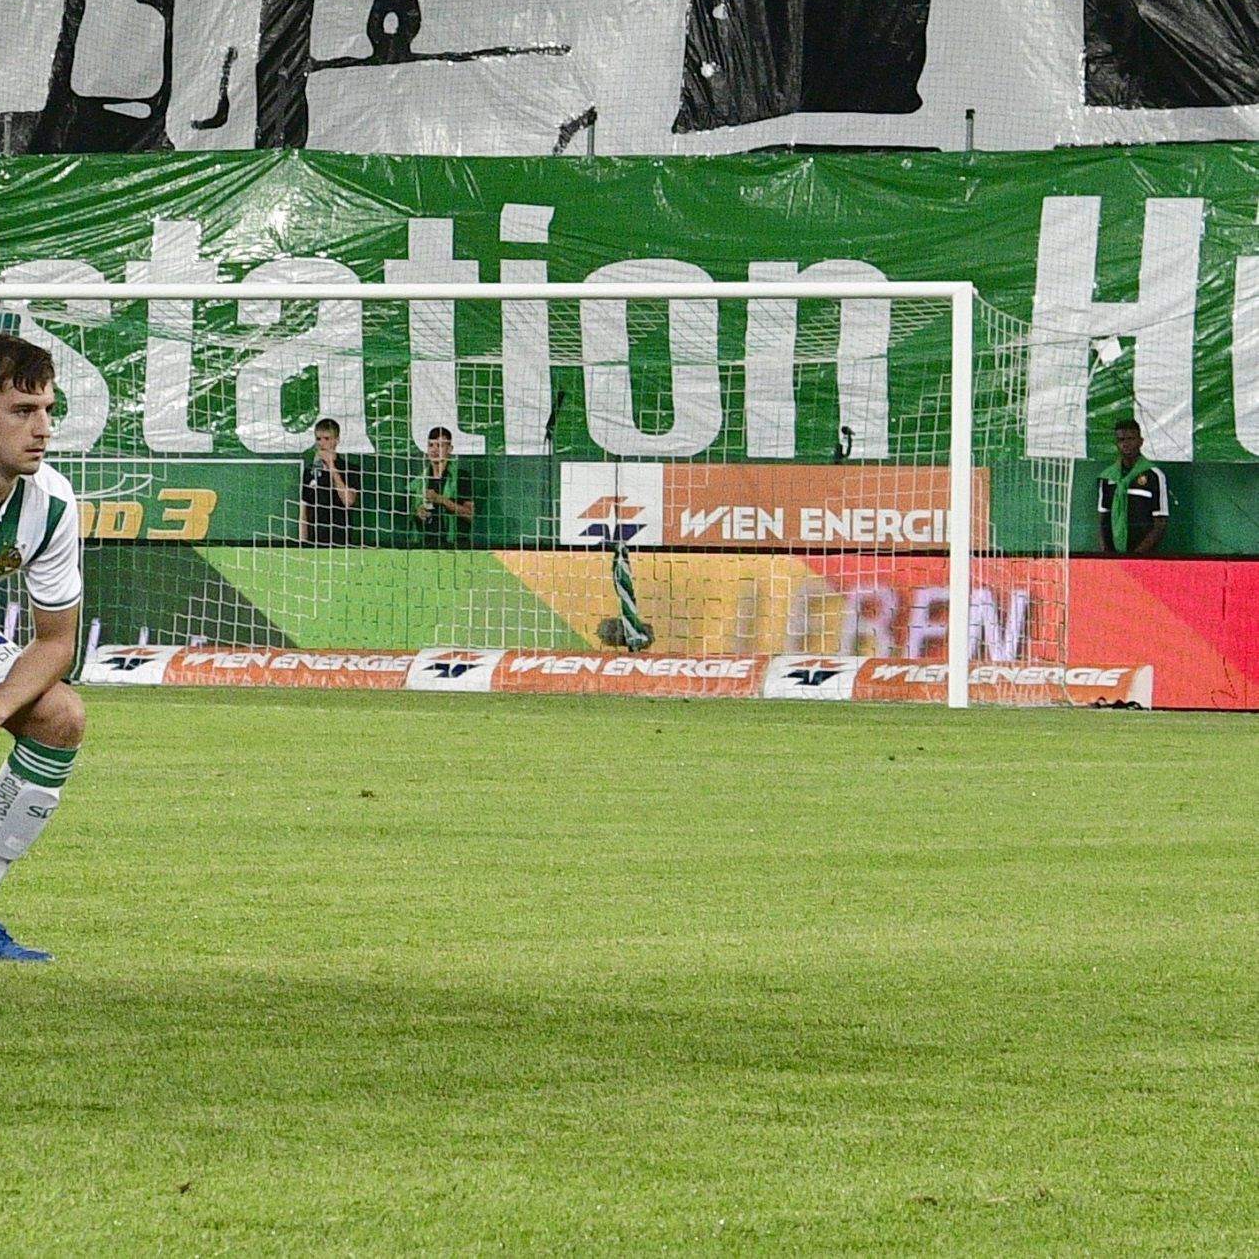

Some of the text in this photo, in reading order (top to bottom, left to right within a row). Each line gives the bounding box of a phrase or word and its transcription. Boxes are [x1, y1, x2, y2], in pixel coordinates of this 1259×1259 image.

[1027, 196, 1259, 462] H
[147, 488, 217, 540] 3
[680, 505, 952, 542] WIEN ENERGI
[182, 652, 416, 672] WIEN ENERGIE
[509, 655, 758, 678] WIEN ENERGIE
[970, 666, 1131, 687] ENERGIE
